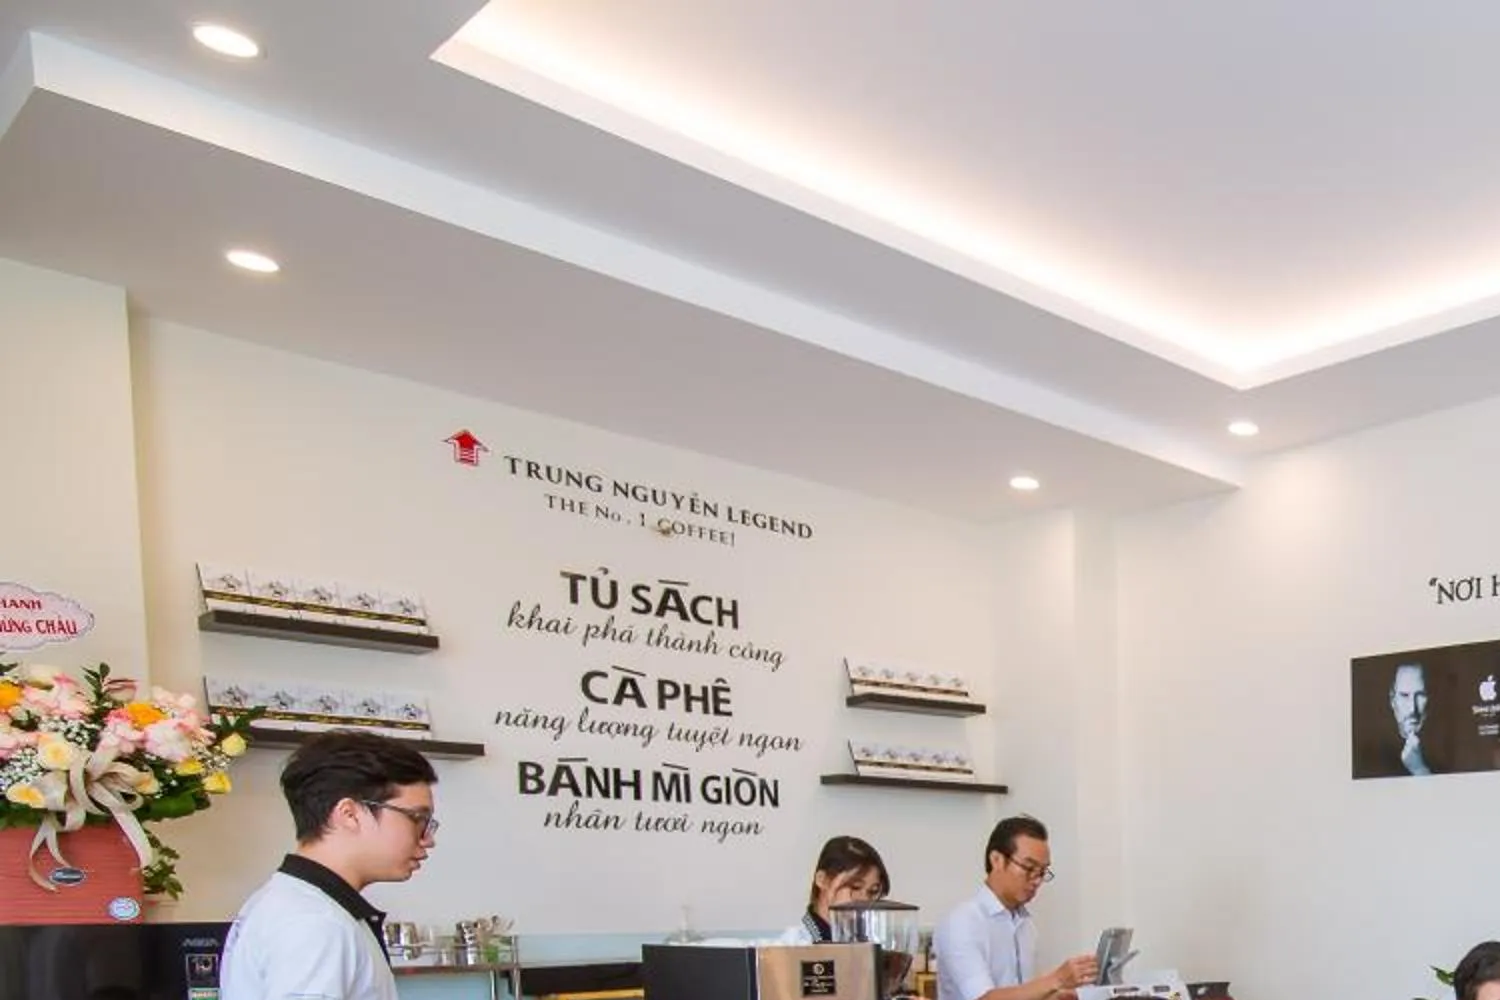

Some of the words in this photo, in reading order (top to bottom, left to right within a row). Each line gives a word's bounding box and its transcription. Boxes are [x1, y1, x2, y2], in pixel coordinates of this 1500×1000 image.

[503, 455, 603, 493] TRUNG
[613, 480, 718, 518] NGUYÊN
[727, 506, 813, 539] LEGEND
[544, 494, 589, 516] THE
[639, 513, 646, 527] 1
[560, 567, 619, 610] TỦ
[506, 601, 577, 635] khai
[582, 616, 637, 646] phá
[646, 623, 721, 656] thành
[728, 641, 785, 672] công
[657, 677, 733, 717] PHÊ
[495, 708, 570, 741] năng
[578, 706, 657, 748] lượng
[667, 722, 733, 752] tuyệt
[739, 732, 804, 758] ngon
[634, 810, 693, 832] tươi
[701, 819, 763, 843] ngon
